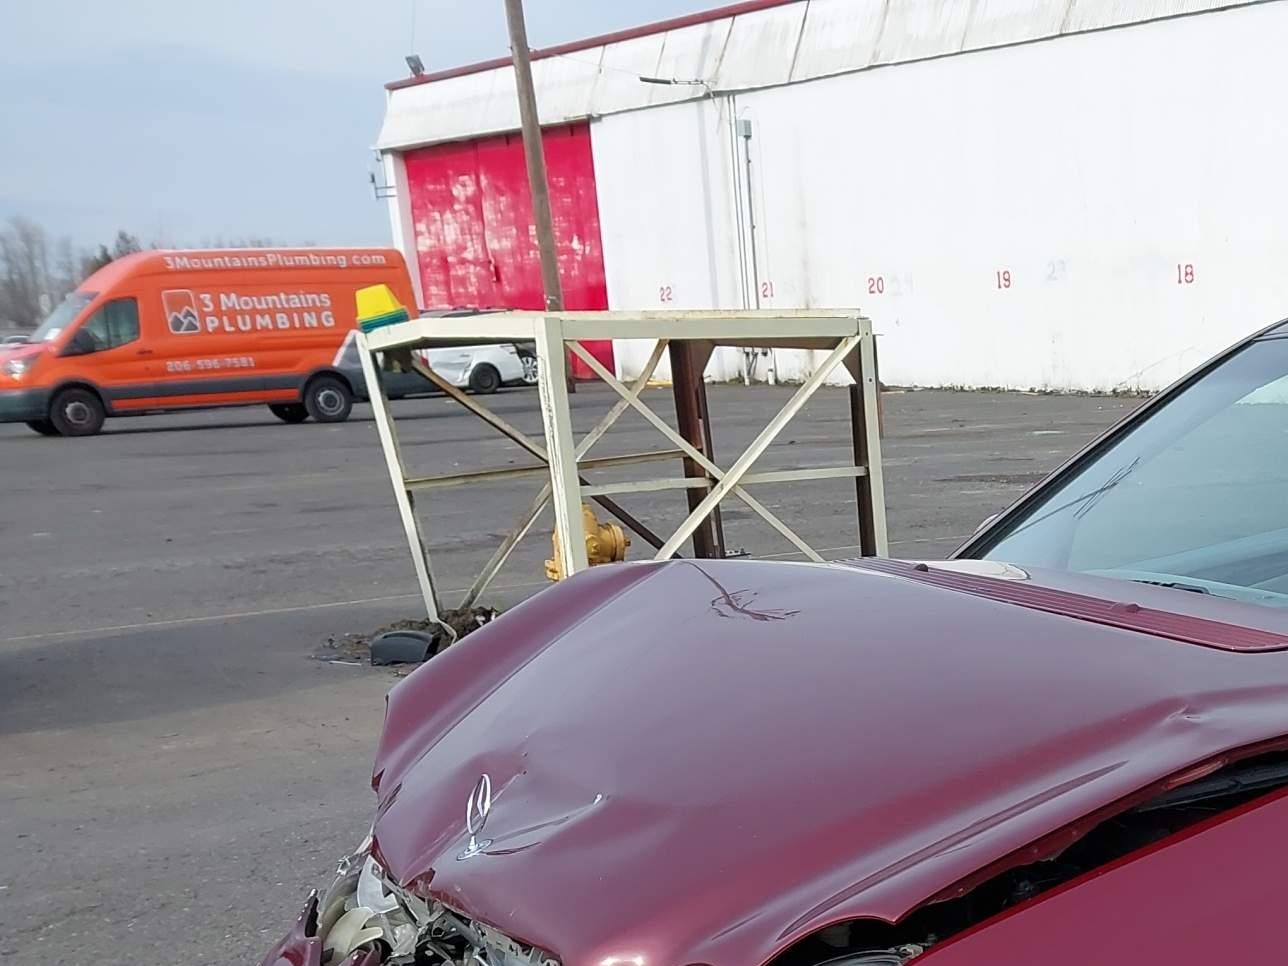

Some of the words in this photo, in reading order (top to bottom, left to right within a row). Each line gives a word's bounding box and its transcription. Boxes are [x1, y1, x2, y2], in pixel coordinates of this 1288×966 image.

[996, 270, 1012, 289] 19
[1176, 263, 1195, 285] 18
[659, 286, 673, 302] 22
[762, 281, 774, 298] 21
[868, 276, 885, 294] 20
[200, 293, 214, 312] 3
[219, 292, 331, 311] Mountains
[205, 311, 335, 332] PLUMBING
